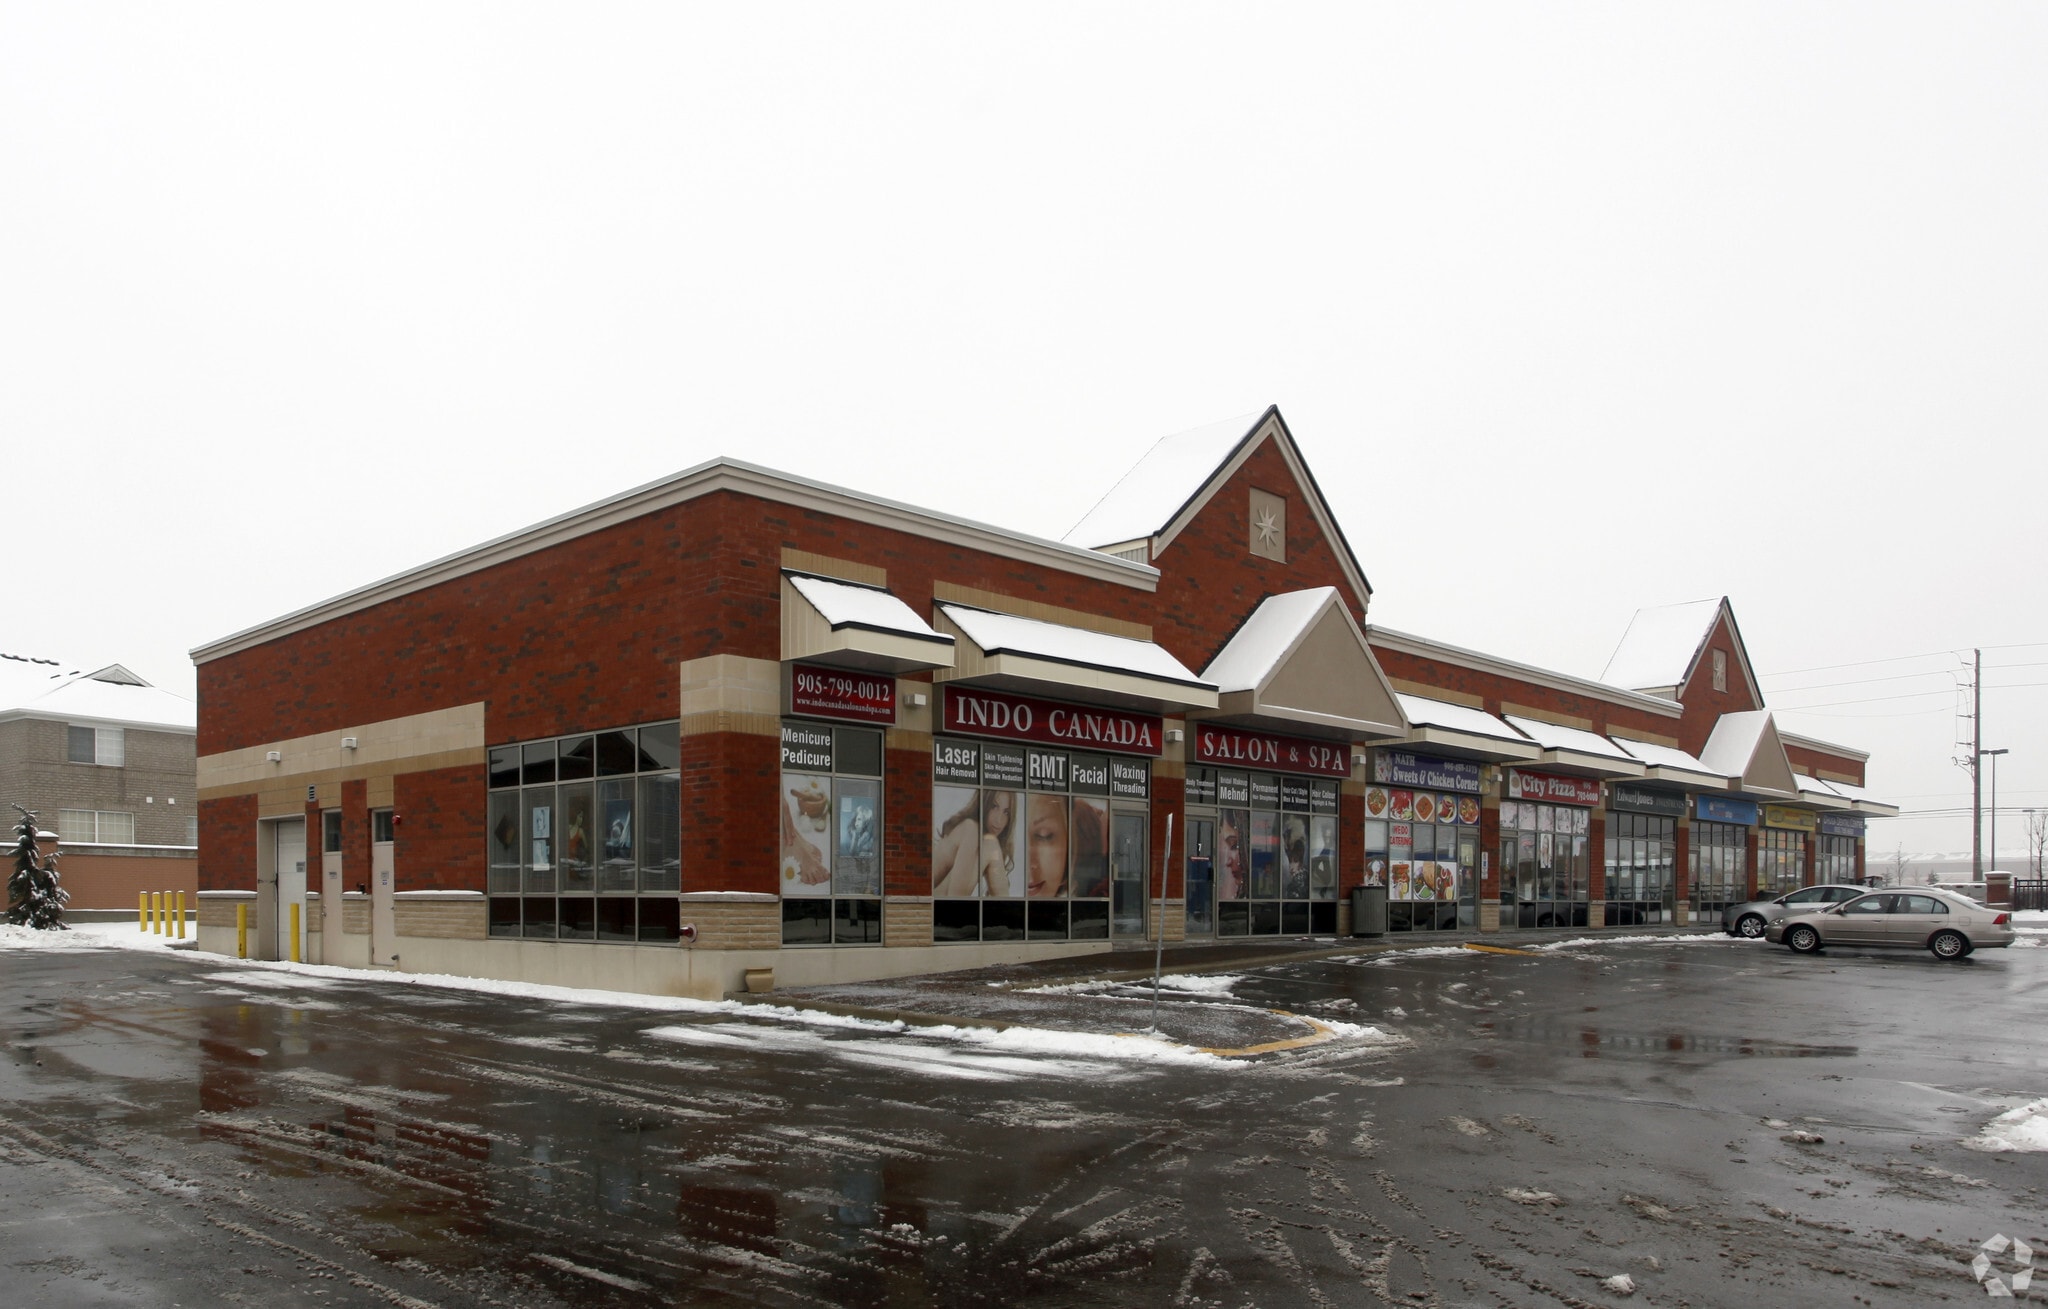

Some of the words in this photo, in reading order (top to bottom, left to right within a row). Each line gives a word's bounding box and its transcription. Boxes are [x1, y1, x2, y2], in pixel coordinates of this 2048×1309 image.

[797, 673, 890, 702] 905-799-0012
[796, 697, 891, 715] www.indocanadasalonandspa.com
[956, 695, 1033, 732] INDO
[1049, 709, 1153, 748] CANADA
[782, 727, 831, 746] Menicure
[782, 747, 831, 767] Pedicure
[935, 743, 977, 766] Laser
[984, 752, 996, 761] Skin
[1203, 732, 1279, 763] SALON
[1290, 747, 1298, 763] &
[1308, 745, 1345, 771] SPA
[1395, 753, 1415, 766] NATH
[935, 765, 949, 775] Hair
[950, 766, 977, 778] Removal
[1029, 753, 1066, 780] RMT
[1072, 764, 1107, 785] Facial
[1113, 763, 1146, 783] Waxing
[1393, 766, 1419, 785] Sweets
[1420, 770, 1426, 785] &
[1428, 771, 1454, 789] Chicken
[1456, 775, 1478, 790] Corner
[1521, 774, 1546, 798] City
[1548, 777, 1576, 797] Pizza
[1113, 781, 1146, 796] Threading
[1220, 786, 1248, 802] Mehndi
